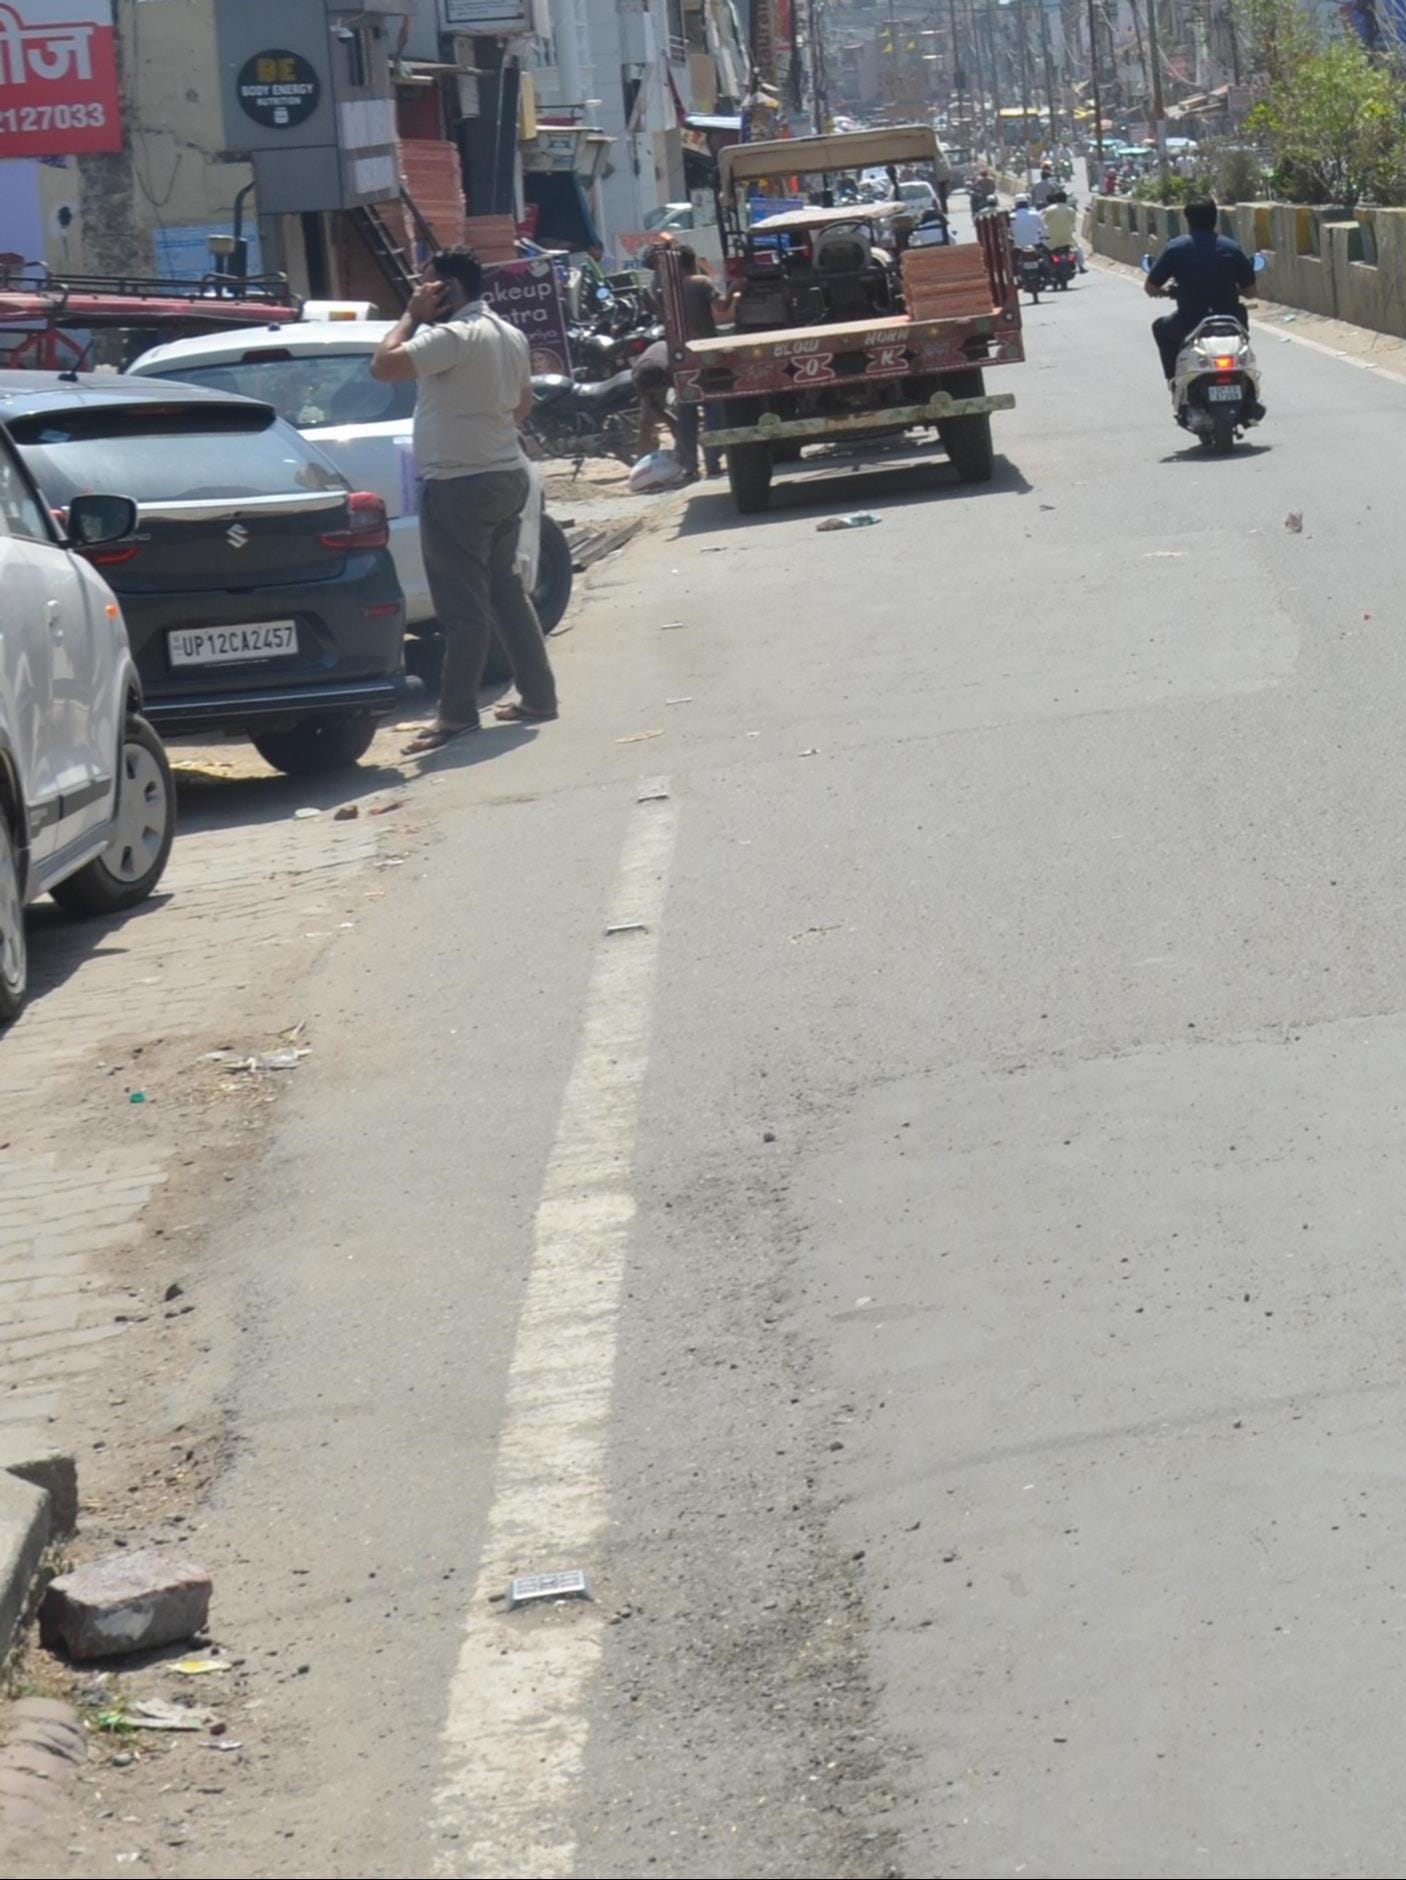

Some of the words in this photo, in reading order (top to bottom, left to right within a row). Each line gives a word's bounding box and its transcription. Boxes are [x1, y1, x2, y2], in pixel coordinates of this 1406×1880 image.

[256, 58, 297, 82] BE
[241, 85, 269, 96] BODY
[272, 84, 314, 95] ENERGY
[481, 281, 552, 303] akeup
[773, 340, 820, 357] BLOW
[865, 330, 909, 345] HORN
[182, 626, 293, 657] UP12CA2457
